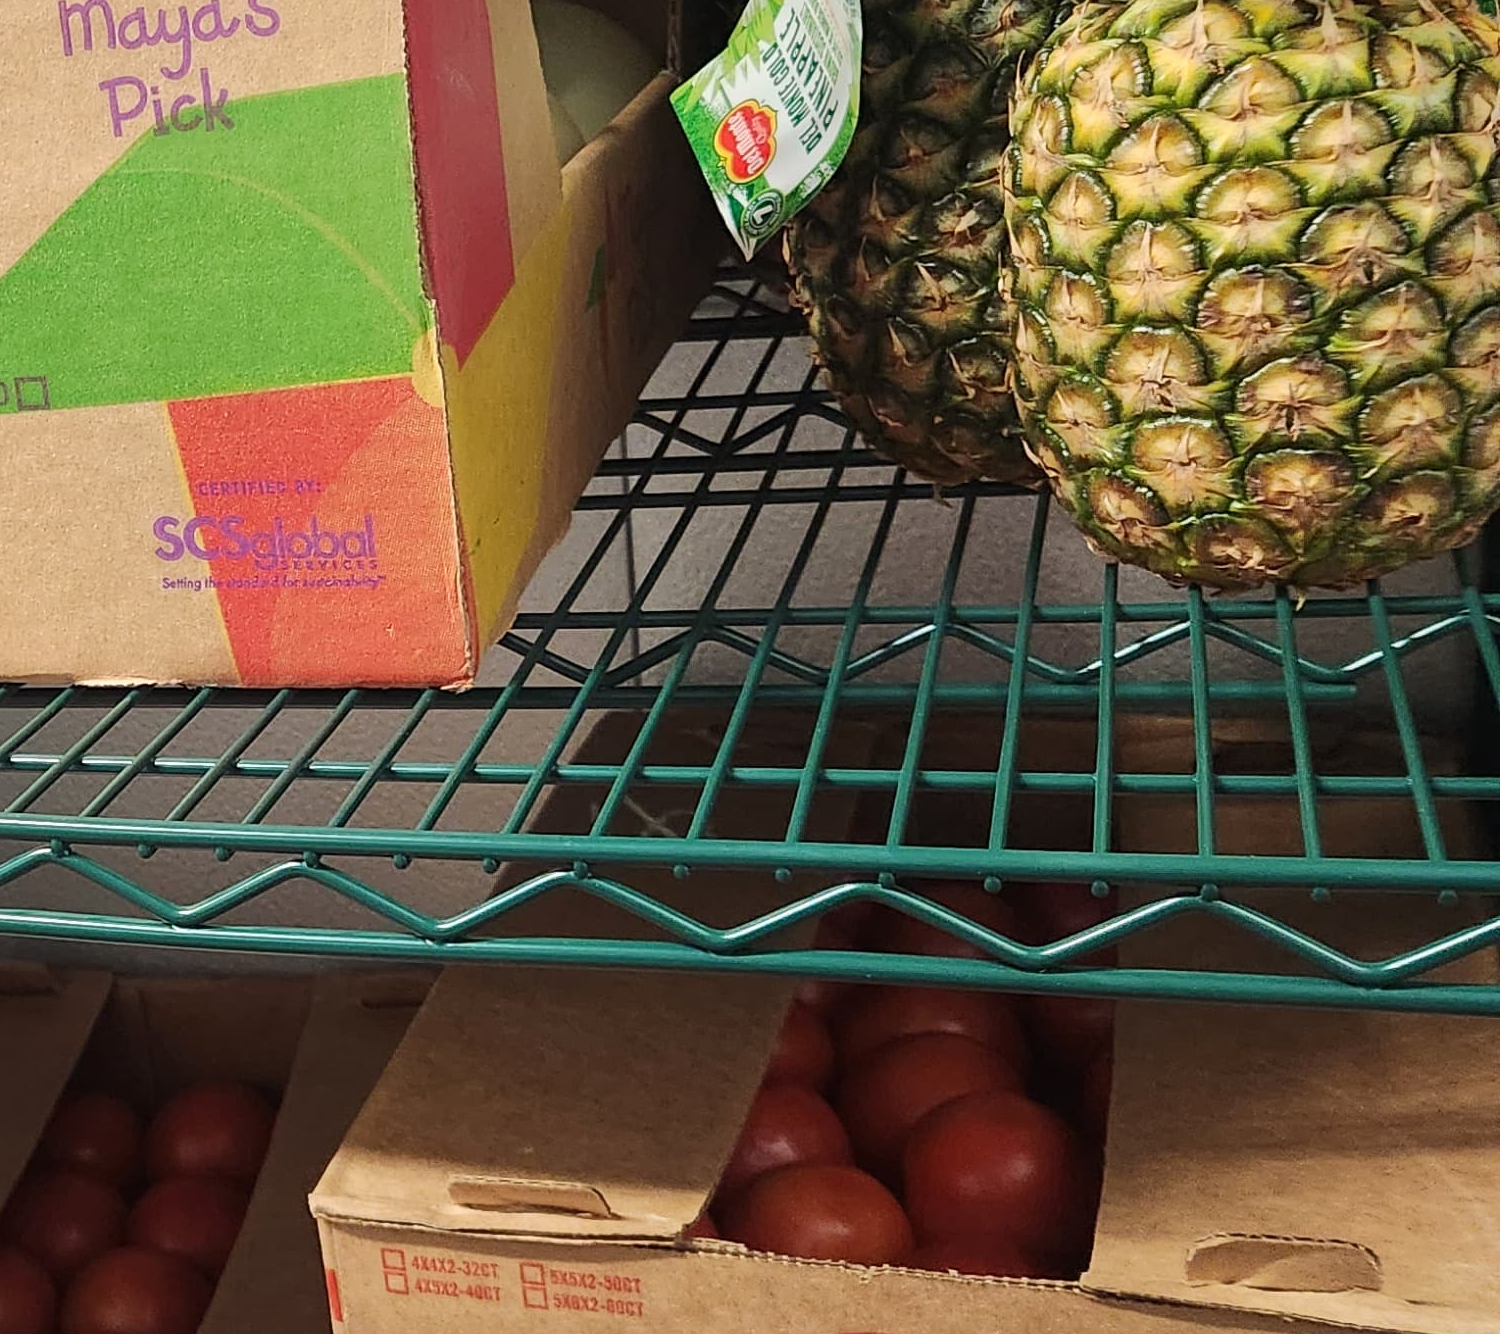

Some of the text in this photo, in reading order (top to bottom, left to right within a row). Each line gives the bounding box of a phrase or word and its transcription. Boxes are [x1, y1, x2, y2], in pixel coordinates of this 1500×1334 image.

[762, 42, 790, 86] GOLD
[780, 8, 839, 132] PINEAPPLE
[99, 67, 237, 139] Pick
[778, 77, 811, 128] MONTE
[799, 119, 822, 155] DEL
[196, 479, 324, 497] CERTIFIED BY:
[161, 577, 201, 592] Setting
[204, 575, 221, 589] the
[282, 575, 299, 588] for
[278, 559, 379, 572] SERVICES
